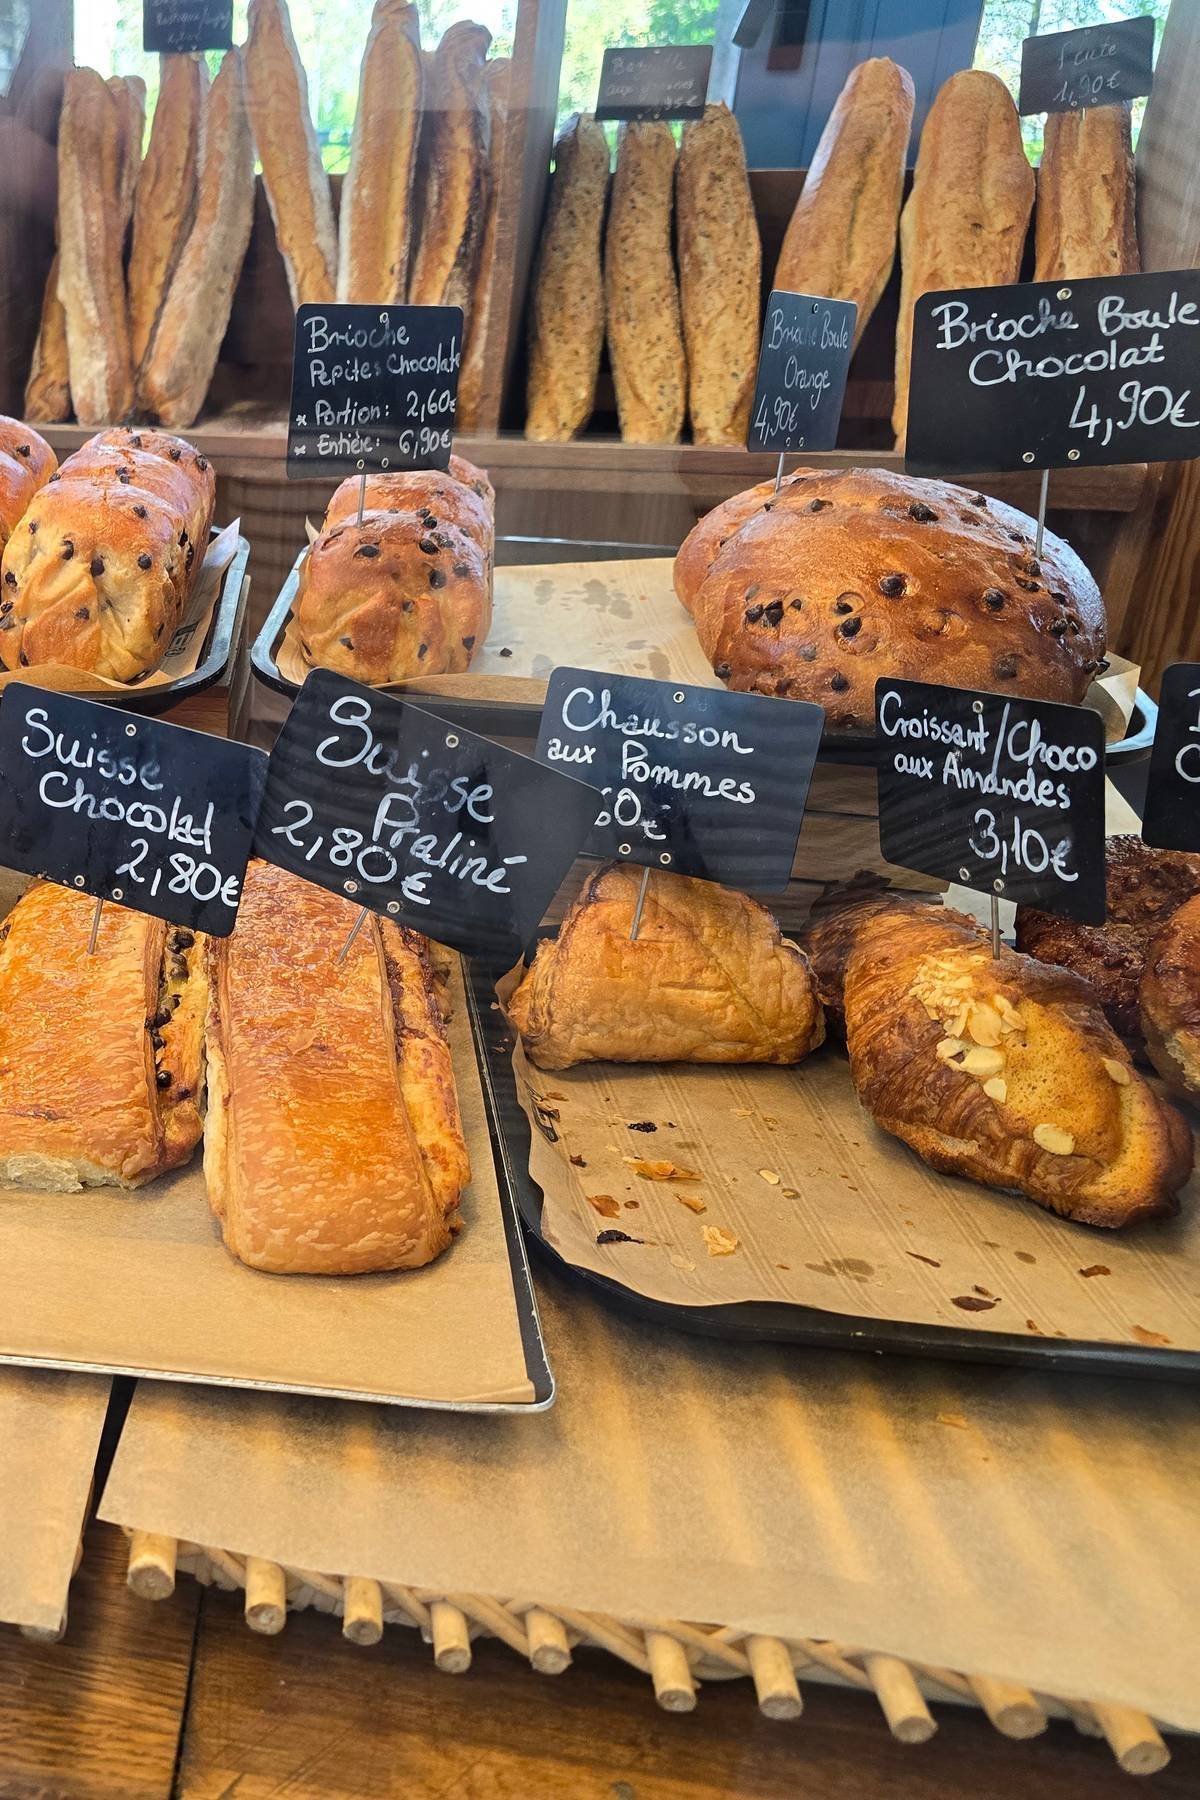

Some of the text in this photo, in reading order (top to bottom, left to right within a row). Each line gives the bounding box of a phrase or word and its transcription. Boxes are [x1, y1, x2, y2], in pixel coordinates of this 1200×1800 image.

[303, 316, 410, 354] Brioche
[820, 309, 849, 351] Boule
[931, 291, 1200, 350] Brioche Boule
[784, 354, 831, 411] Orange
[968, 332, 1166, 386] Chocolat
[406, 388, 457, 423] 2,60€
[753, 393, 799, 446] 4,90€
[1068, 380, 1200, 447] 4,90€
[399, 426, 452, 460] 6,90€
[21, 707, 165, 792] Suisse
[561, 686, 755, 755] Chausson
[546, 737, 757, 804] aux Pommes
[893, 749, 1071, 810] aux Amandes
[38, 770, 215, 855] Chocolat
[372, 792, 528, 894] Praliné
[114, 838, 240, 908] 2,80€
[968, 807, 1079, 882] 3,10€
